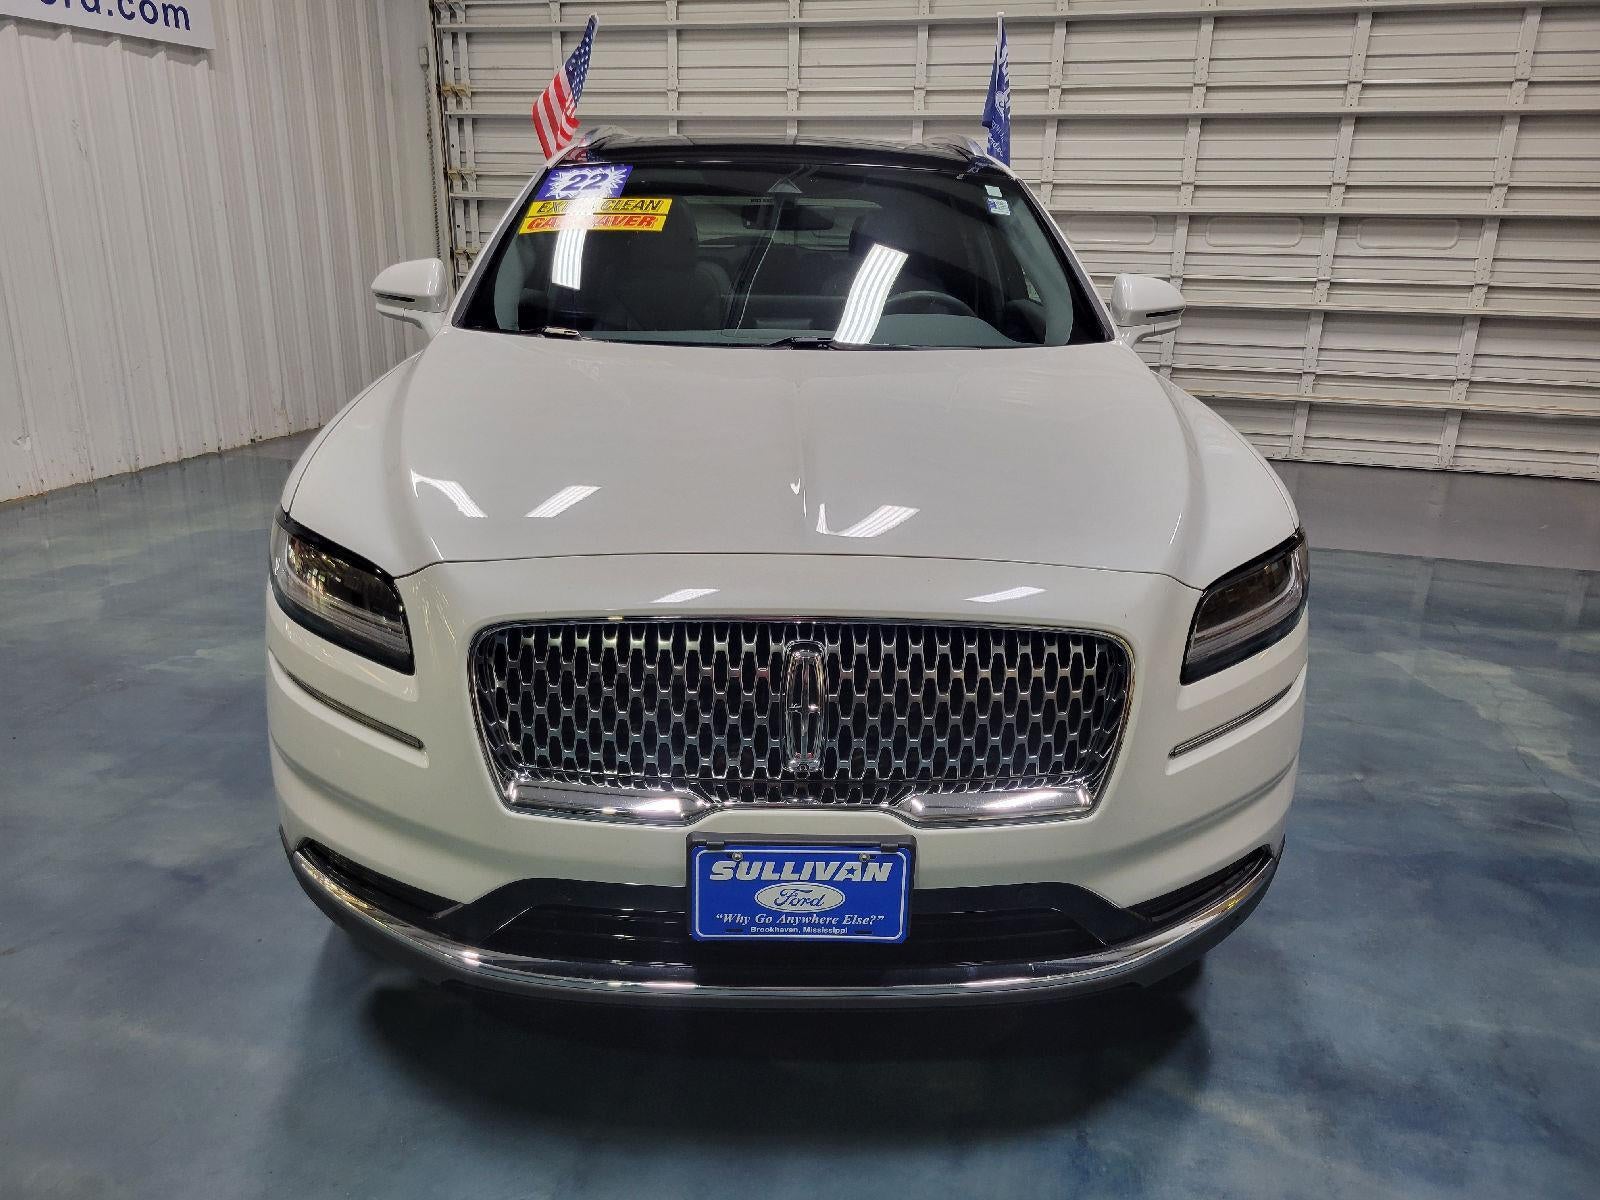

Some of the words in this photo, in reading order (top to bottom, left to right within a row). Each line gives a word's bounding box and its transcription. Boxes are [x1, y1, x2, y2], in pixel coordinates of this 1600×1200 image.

[40, 0, 191, 31] .com
[560, 173, 609, 192] 22
[601, 199, 662, 212] CLEAN
[584, 214, 657, 228] AVER
[710, 860, 893, 882] SULLIVAN
[773, 888, 825, 907] Ford
[755, 913, 773, 924] Go
[778, 914, 838, 926] Anywhere
[750, 926, 801, 934] Brookhaven,
[803, 926, 848, 935] Mississippi
